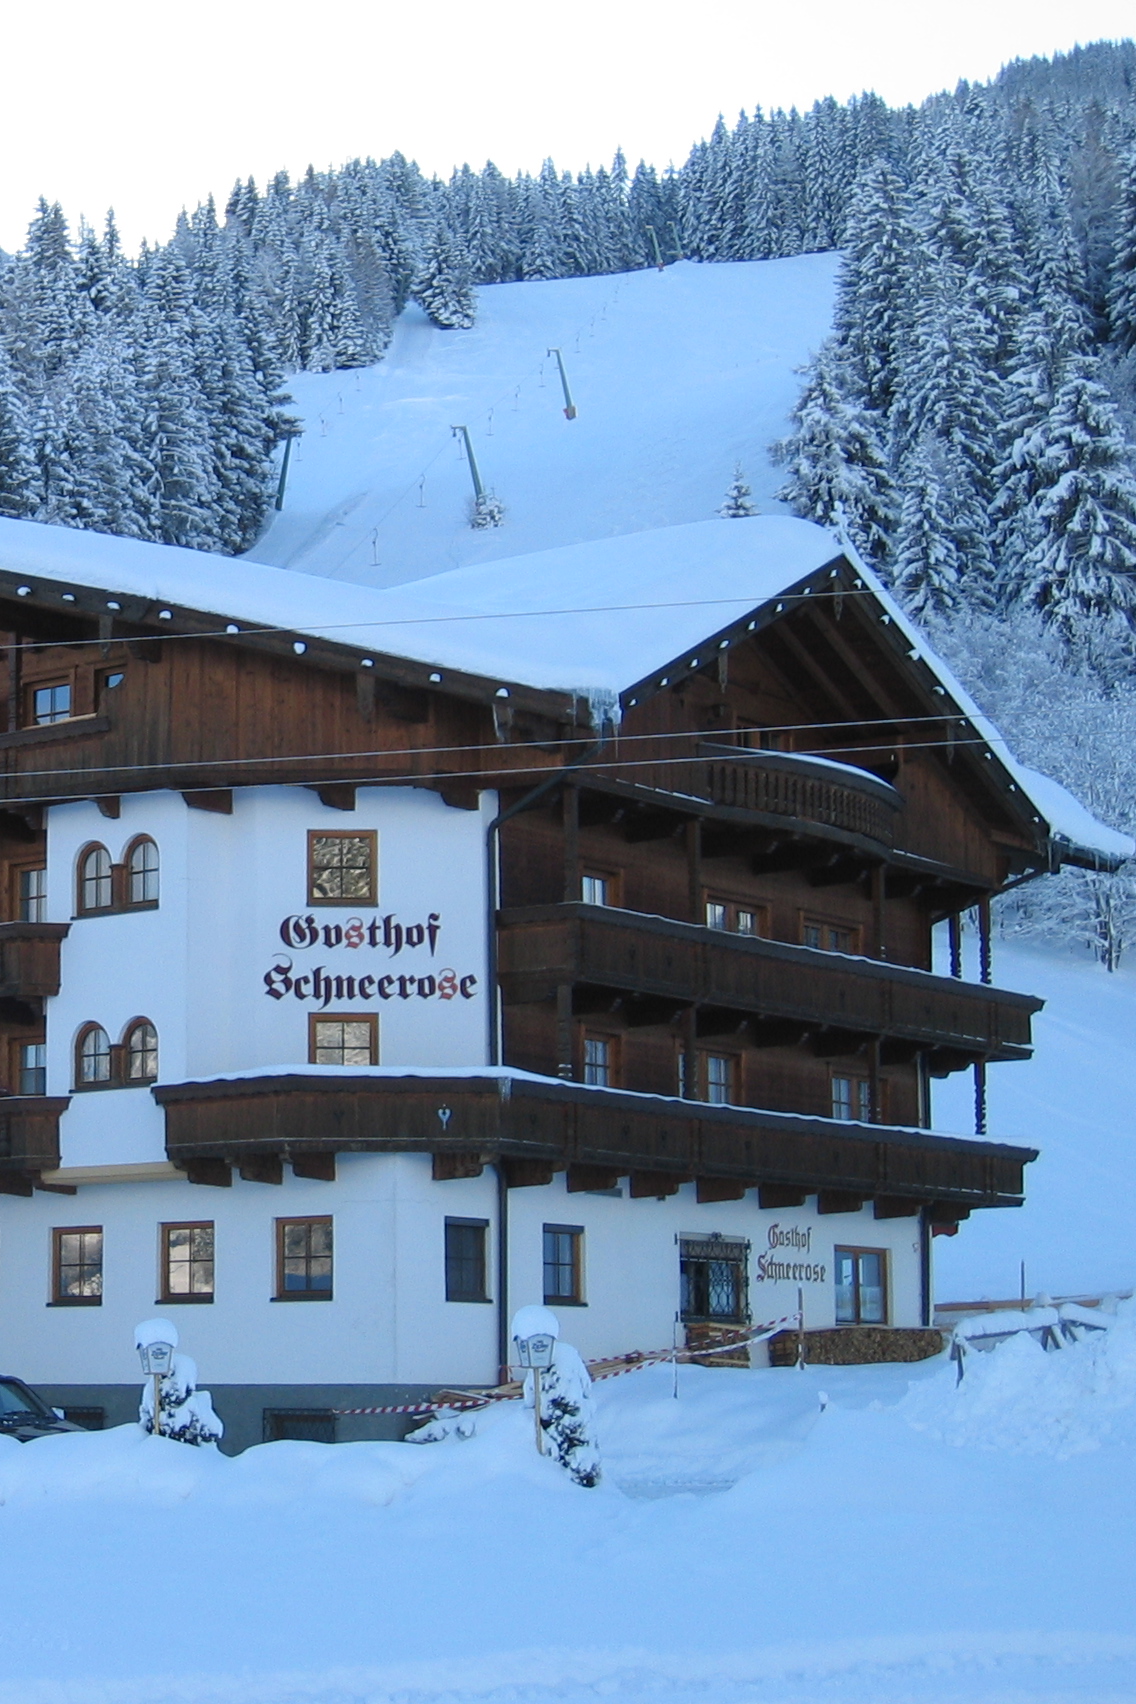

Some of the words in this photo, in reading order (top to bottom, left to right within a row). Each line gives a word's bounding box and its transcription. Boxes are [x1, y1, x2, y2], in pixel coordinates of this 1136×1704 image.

[263, 953, 479, 1010] Schneerose
[767, 1222, 812, 1254] Gasthof
[756, 1250, 826, 1285] Schneerose
